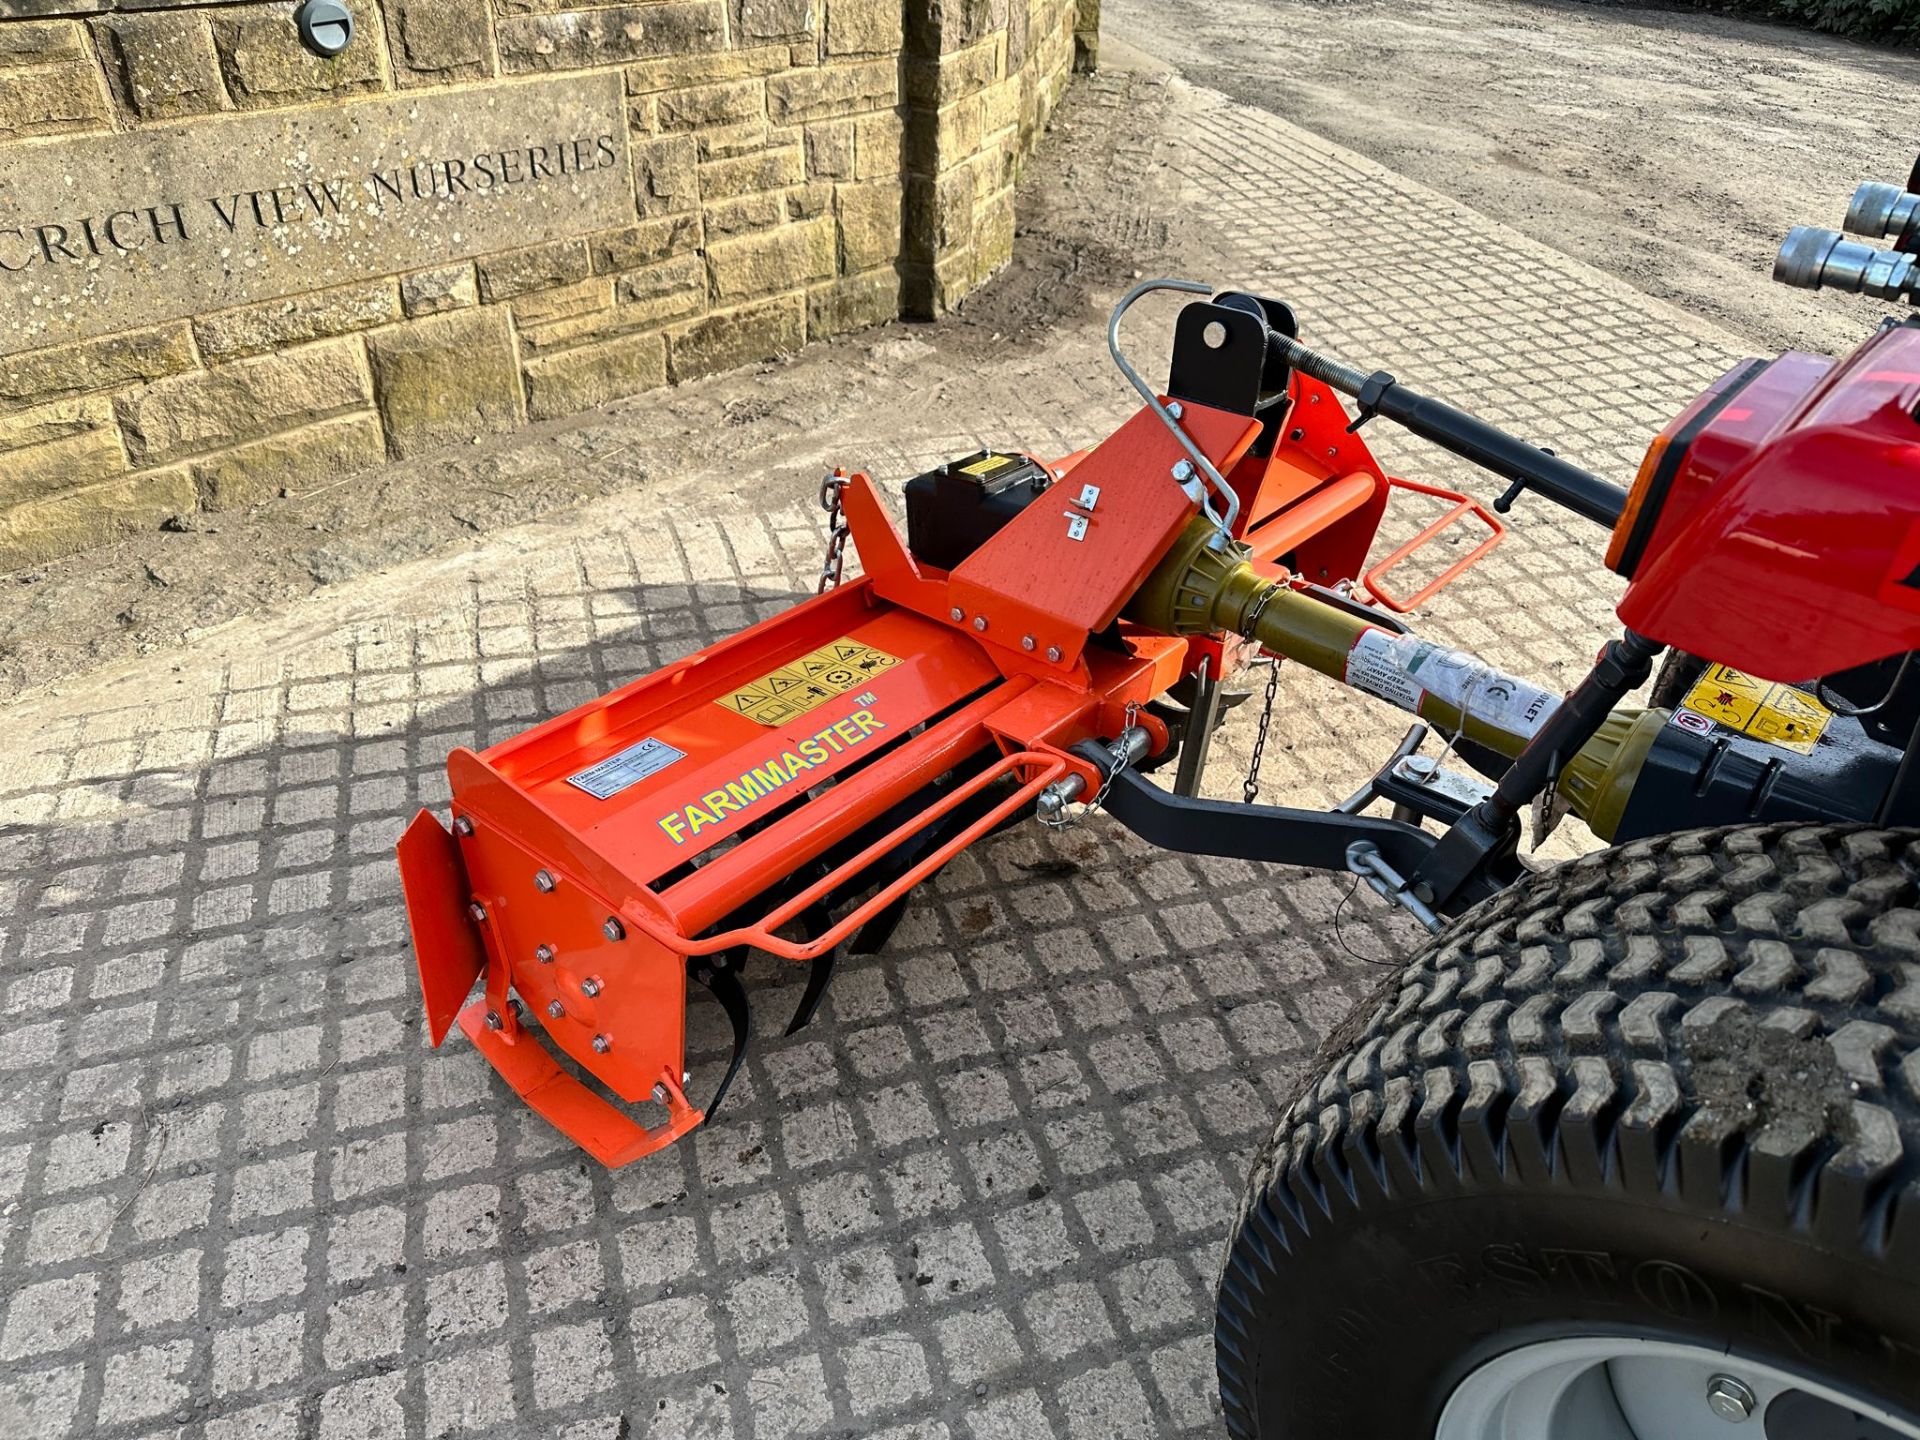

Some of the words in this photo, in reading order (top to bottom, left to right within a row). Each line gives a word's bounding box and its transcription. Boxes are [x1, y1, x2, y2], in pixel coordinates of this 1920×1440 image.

[0, 202, 191, 272] CRICH
[207, 178, 350, 234] VIEW
[370, 133, 617, 204] NURSERIES
[841, 676, 864, 691] STOP
[1386, 675, 1405, 685] KEEP
[1384, 686, 1415, 703] ROTATING
[1524, 691, 1551, 723] OKLET
[657, 709, 887, 845] FARMMASTER
